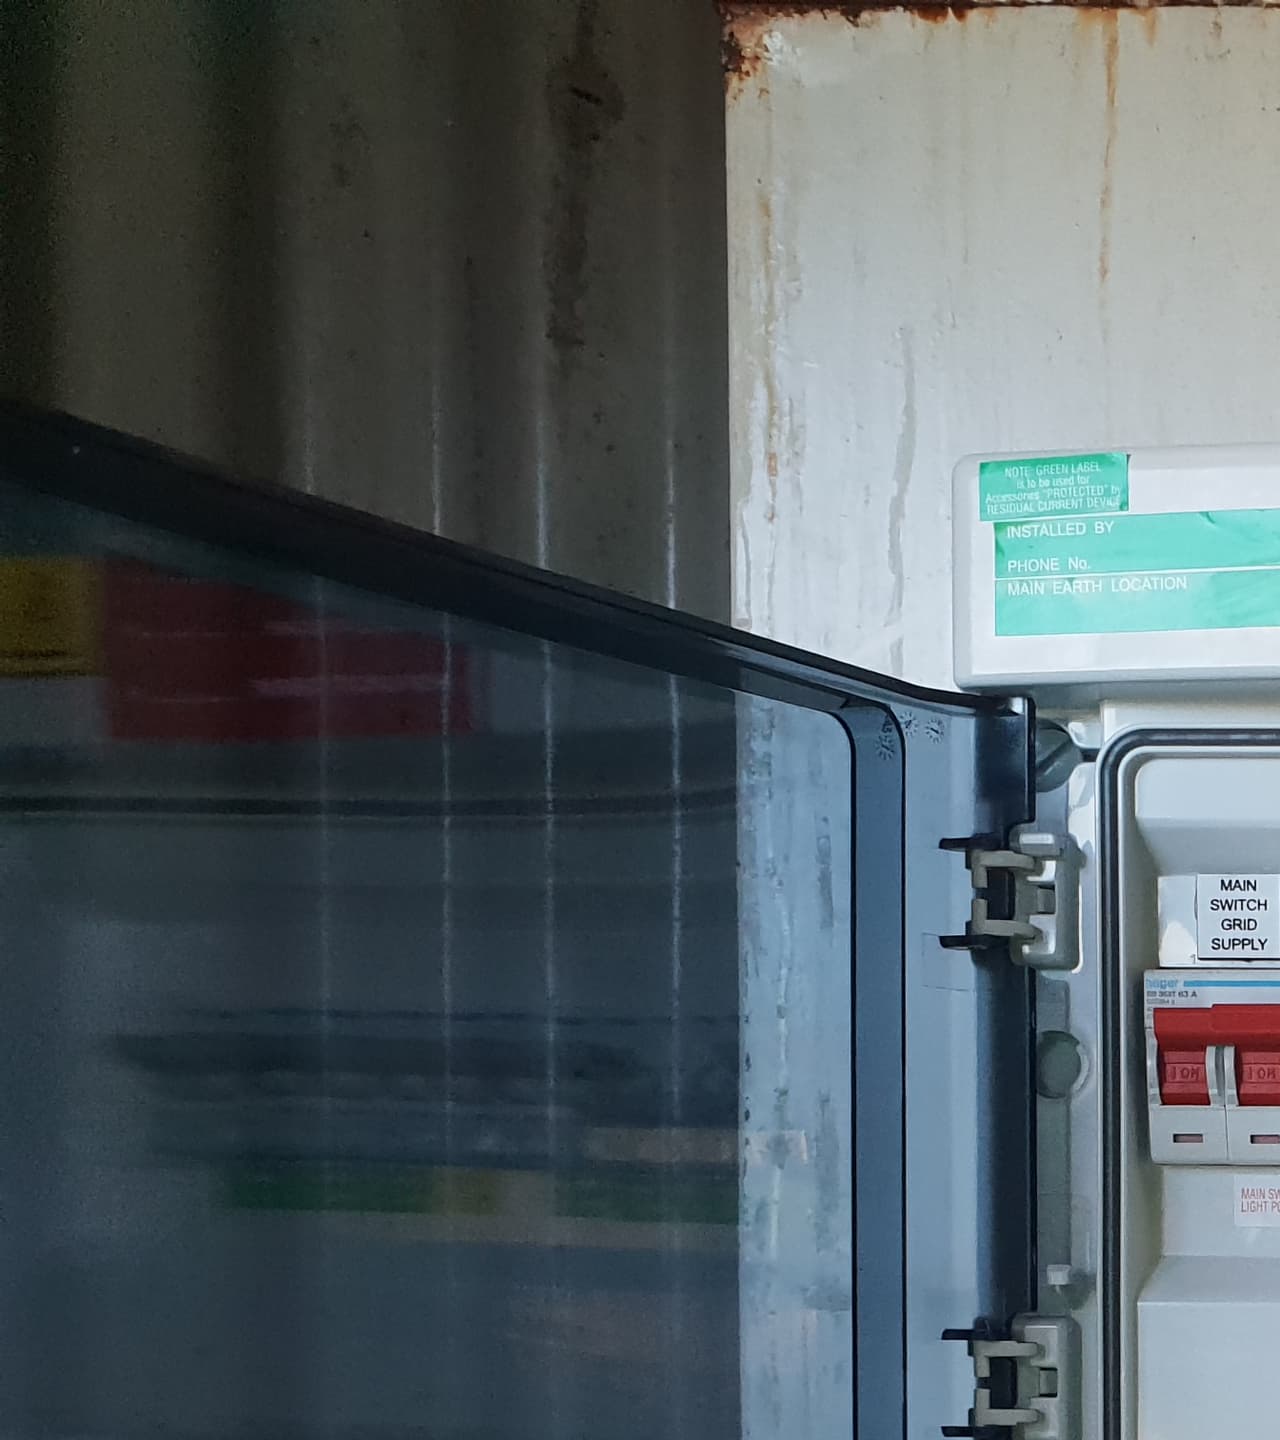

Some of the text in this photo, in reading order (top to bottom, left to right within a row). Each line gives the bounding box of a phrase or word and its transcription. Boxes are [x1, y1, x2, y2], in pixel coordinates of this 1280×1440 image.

[1036, 463, 1069, 475] GREEN
[1071, 461, 1101, 473] LABEL
[1027, 478, 1036, 488] to
[1039, 477, 1050, 487] be
[1052, 476, 1074, 487] used
[1077, 475, 1090, 485] for
[987, 502, 1036, 515] RESIDUAL
[1038, 499, 1083, 512] CURRENT
[1007, 521, 1115, 539] INSTALLED BY
[1007, 556, 1092, 572] PHONE No.
[1007, 576, 1187, 596] MAIN EARTH LOCATION
[1220, 879, 1257, 891] MAIN
[1210, 899, 1268, 911] SWITCH
[1221, 918, 1258, 931] GRID
[1211, 938, 1268, 950] SUPPLY
[1241, 1188, 1266, 1200] MAIN
[1241, 1201, 1269, 1213] LIGHT
